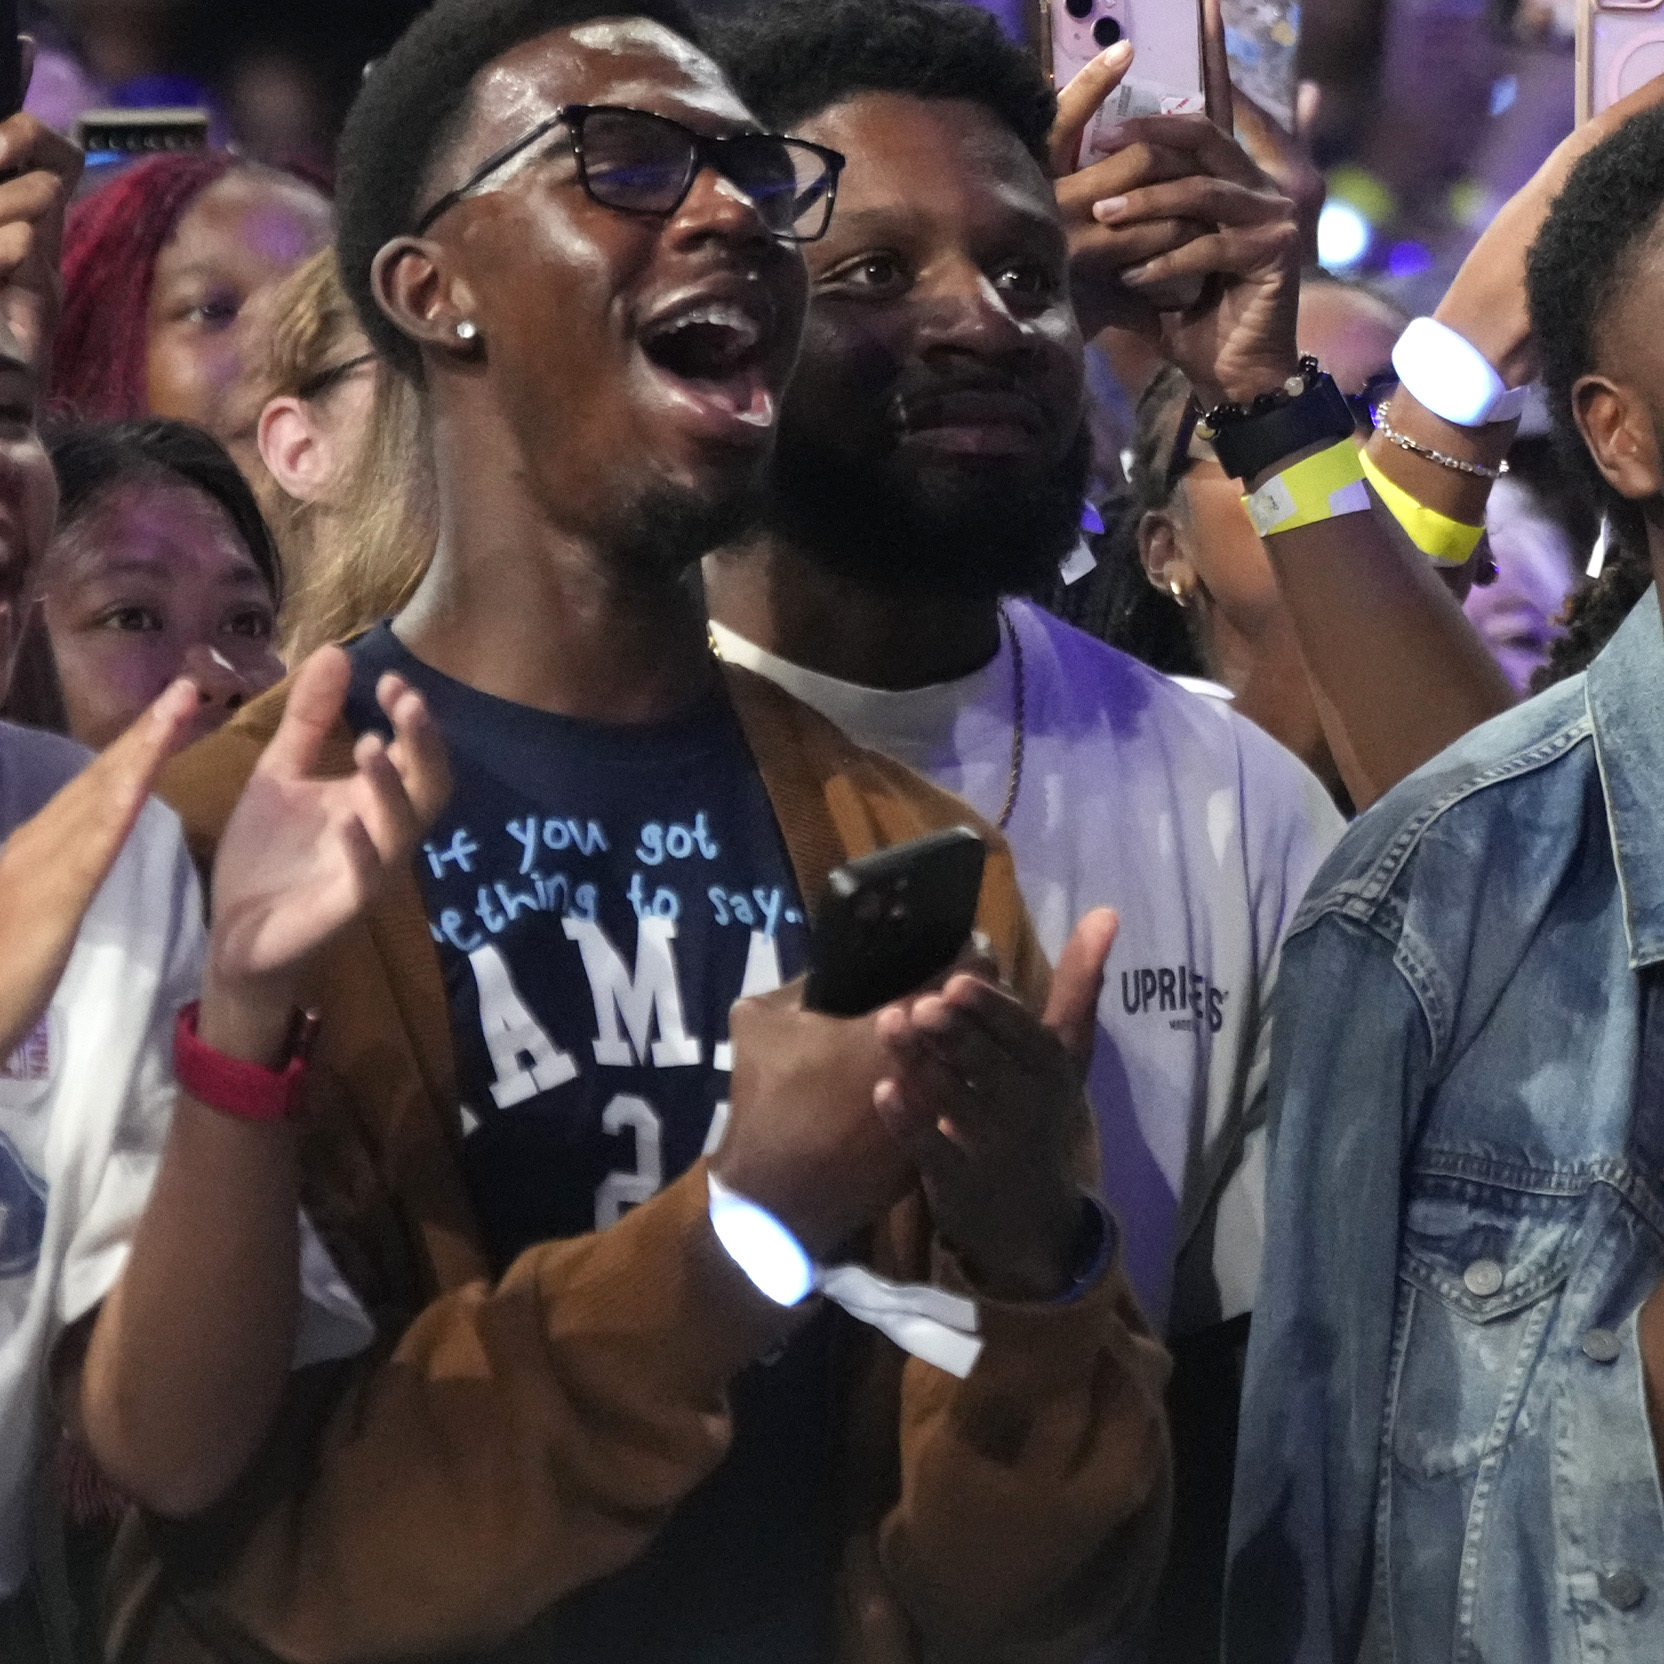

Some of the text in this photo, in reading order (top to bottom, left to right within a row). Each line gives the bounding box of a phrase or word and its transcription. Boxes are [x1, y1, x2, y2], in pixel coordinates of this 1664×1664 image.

[424, 812, 718, 879] if you got
[627, 874, 680, 921] to
